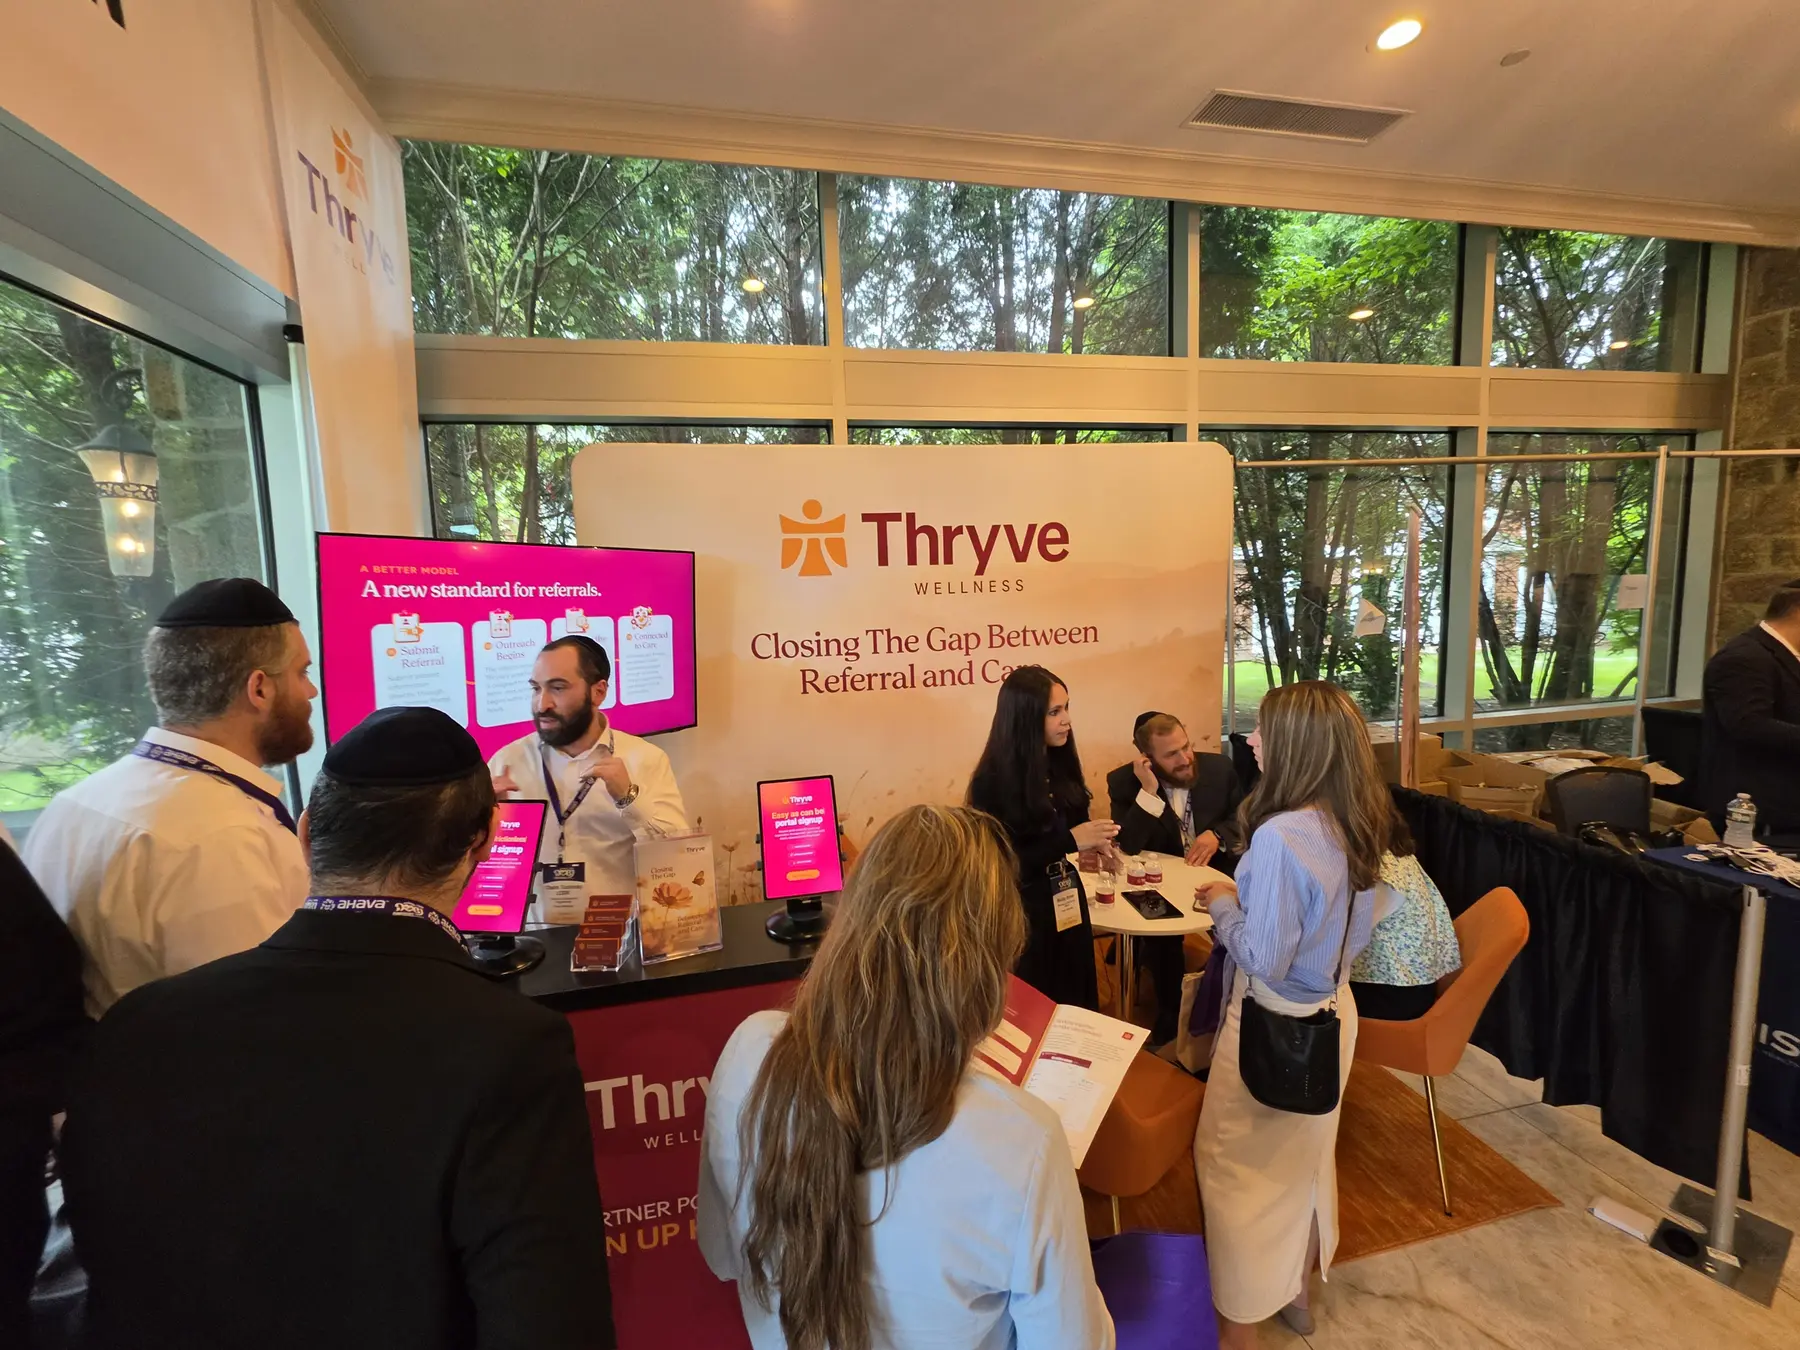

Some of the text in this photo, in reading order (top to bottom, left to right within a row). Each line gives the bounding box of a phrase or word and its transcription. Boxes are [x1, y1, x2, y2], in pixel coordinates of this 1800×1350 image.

[861, 512, 1070, 576] Thryve
[359, 564, 460, 576] A BETTER MODEL
[361, 579, 602, 598] A new standard for referrals.
[914, 579, 1025, 596] WELLNESS
[634, 631, 669, 641] Connected
[750, 623, 1100, 662] Closing The Gap Between
[400, 645, 440, 656] Submit
[495, 638, 536, 650] Outreach
[401, 656, 445, 669] Referral
[496, 651, 526, 661] Begins
[800, 658, 1042, 695] Referral and Ca
[789, 795, 813, 805] Thryve
[771, 811, 789, 820] Easy
[800, 809, 814, 817] can
[774, 816, 823, 829] portal signup
[637, 1222, 681, 1251] UP
